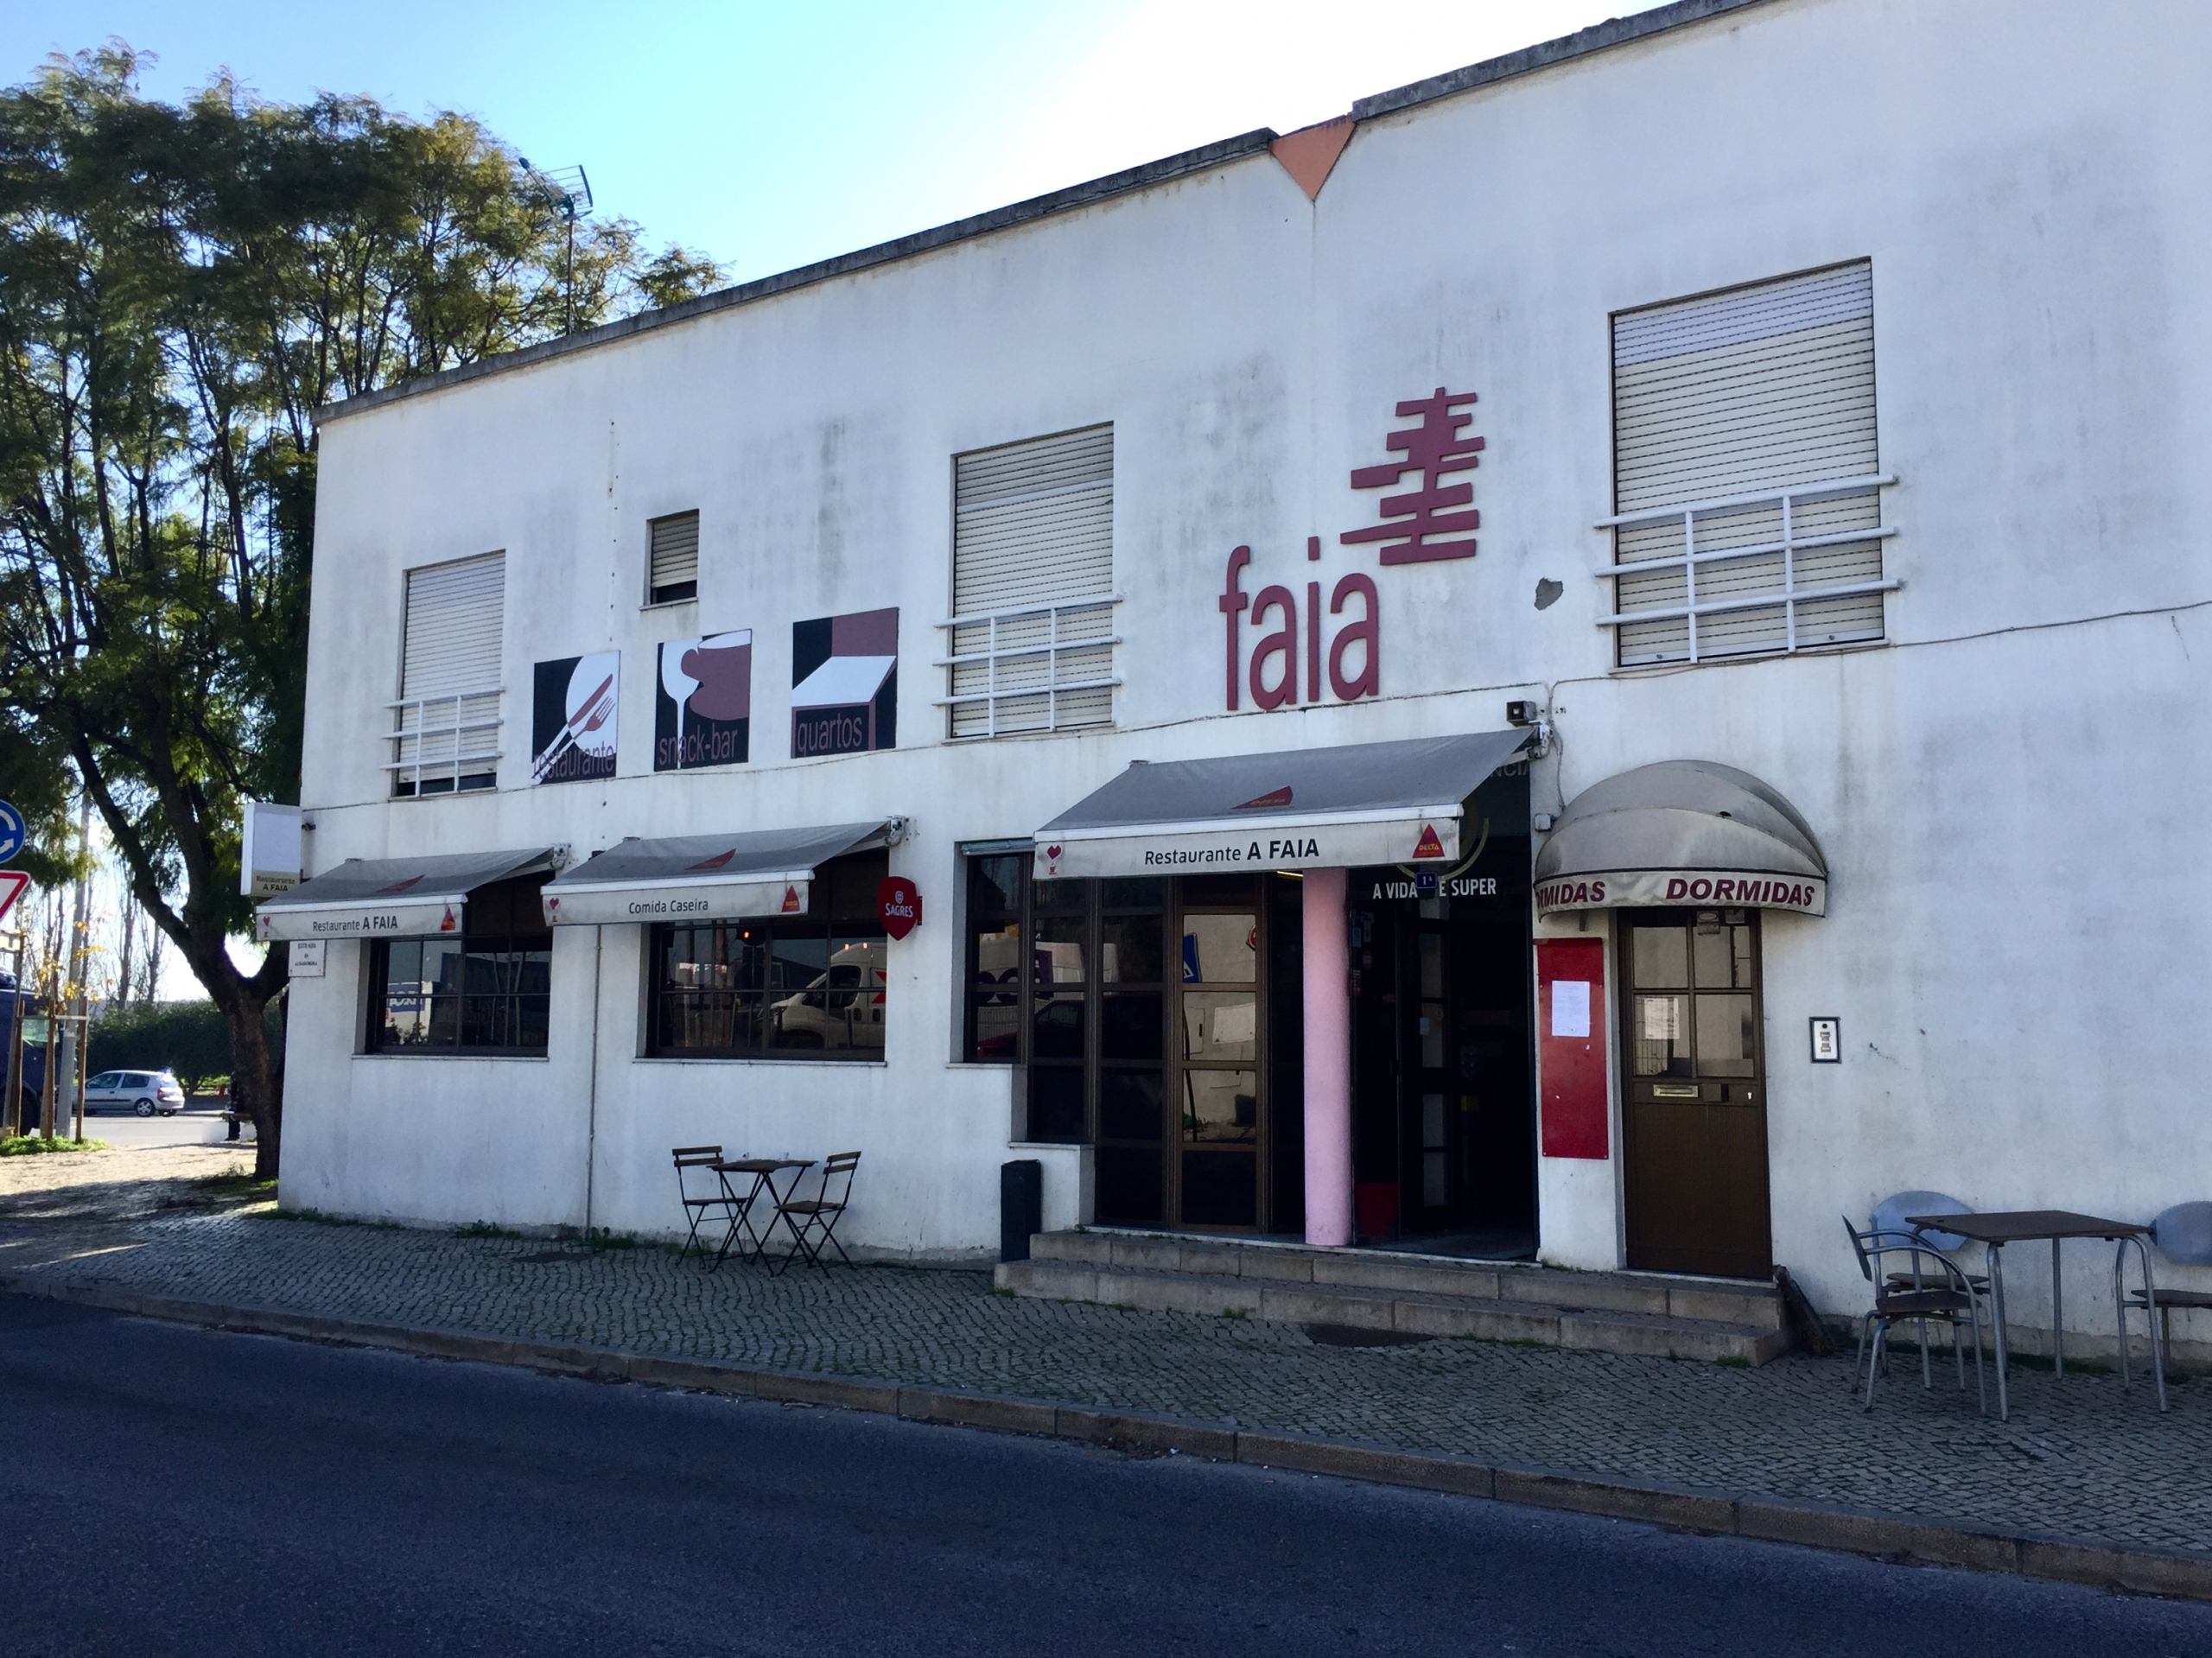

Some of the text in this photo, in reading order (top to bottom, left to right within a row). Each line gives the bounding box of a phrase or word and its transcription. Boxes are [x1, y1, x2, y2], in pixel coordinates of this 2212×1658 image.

[1219, 536, 1379, 711] faia
[658, 722, 739, 765] snack-bar
[796, 712, 863, 757] quartos
[533, 740, 615, 780] restaurante
[1144, 838, 1320, 866] Restaurante A FAIA
[270, 883, 289, 892] FAIA
[1372, 882, 1382, 899] A
[1385, 880, 1419, 899] VIDA
[1451, 878, 1497, 897] SUPER
[1665, 878, 1815, 907] DORMIDAS
[628, 898, 709, 915] Comida Caseira
[885, 902, 914, 918] SAGRES
[312, 915, 398, 932] Restaurante A FAIA
